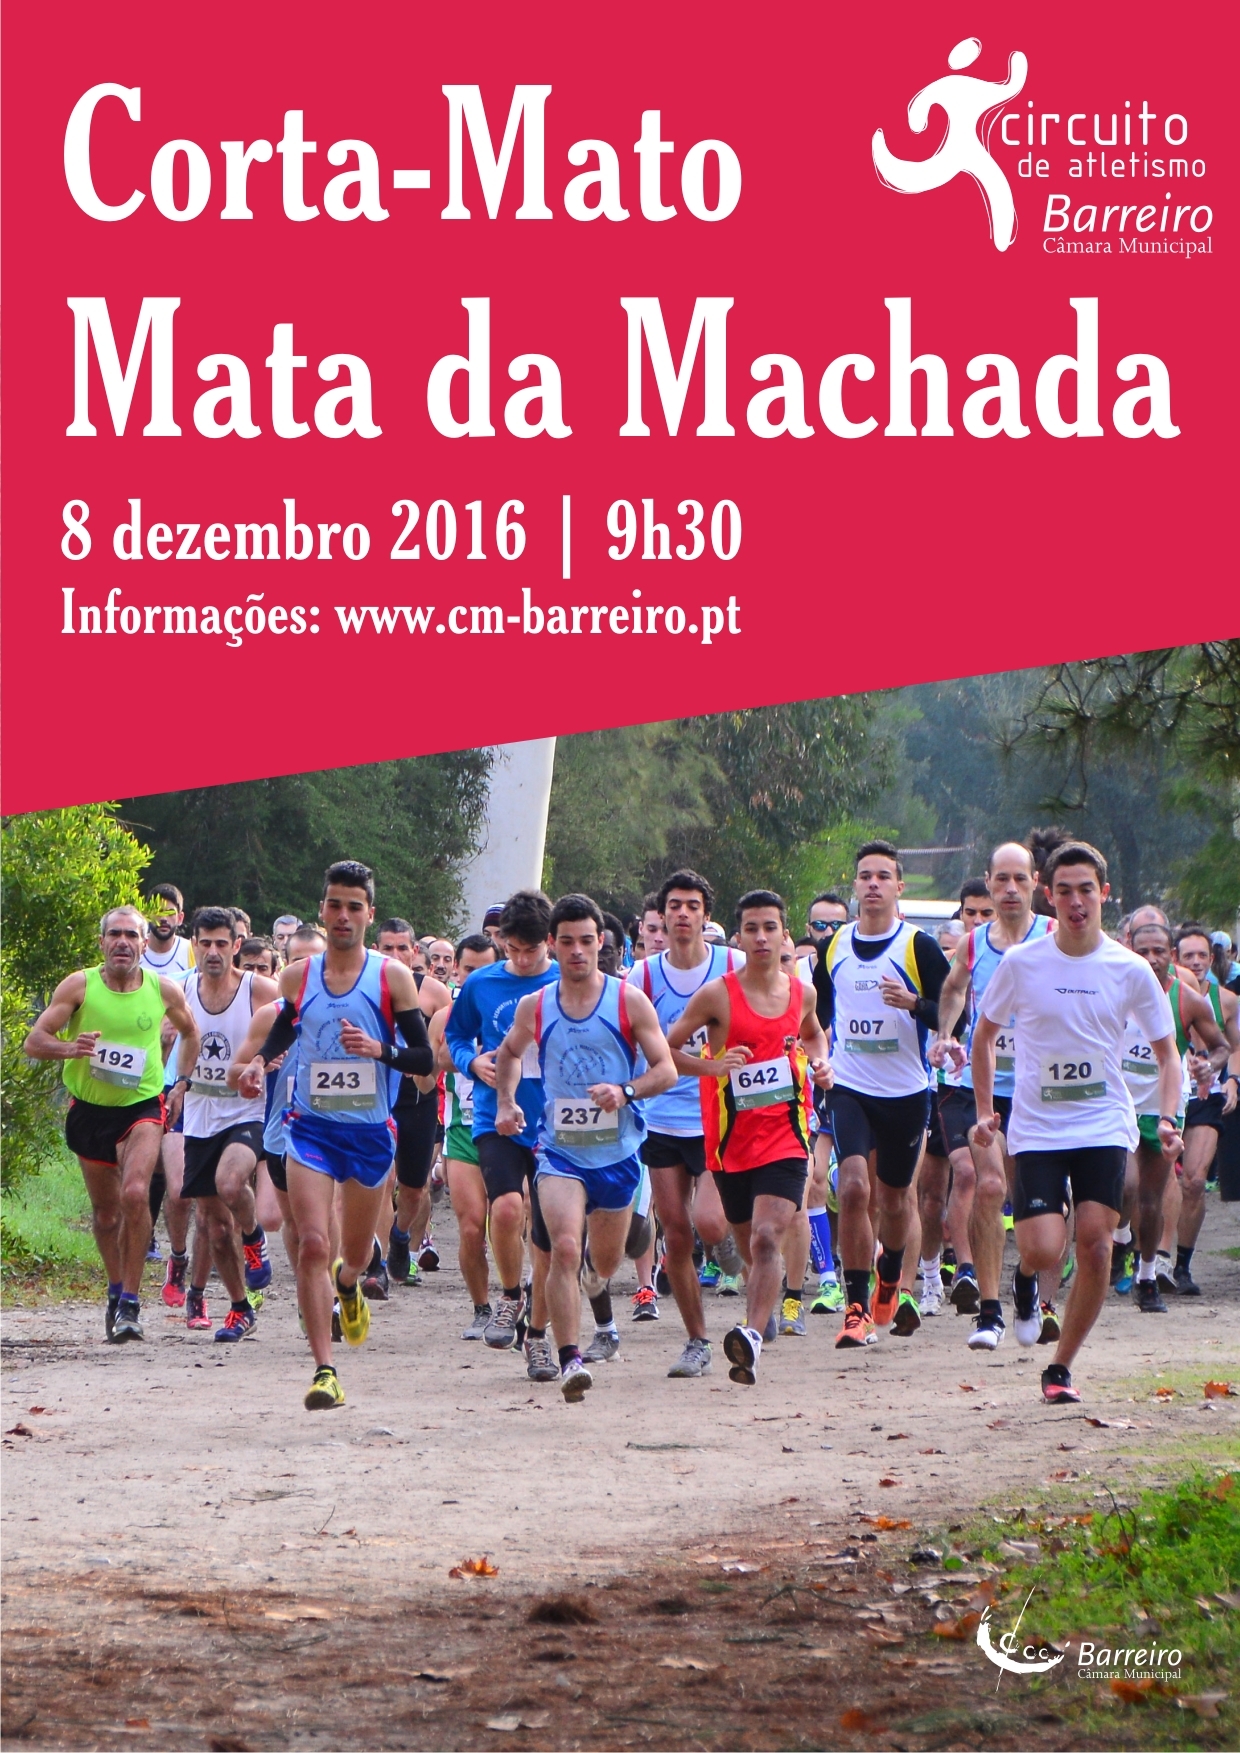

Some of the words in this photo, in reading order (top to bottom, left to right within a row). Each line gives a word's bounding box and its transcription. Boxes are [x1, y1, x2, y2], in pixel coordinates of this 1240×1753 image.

[849, 1019, 884, 1035] 007
[97, 1048, 134, 1069] 192
[1129, 1044, 1157, 1060] 42
[195, 1065, 226, 1081] 132
[316, 1071, 361, 1089] 243
[738, 1067, 779, 1088] 642
[1048, 1061, 1093, 1081] 120
[561, 1107, 603, 1125] 237
